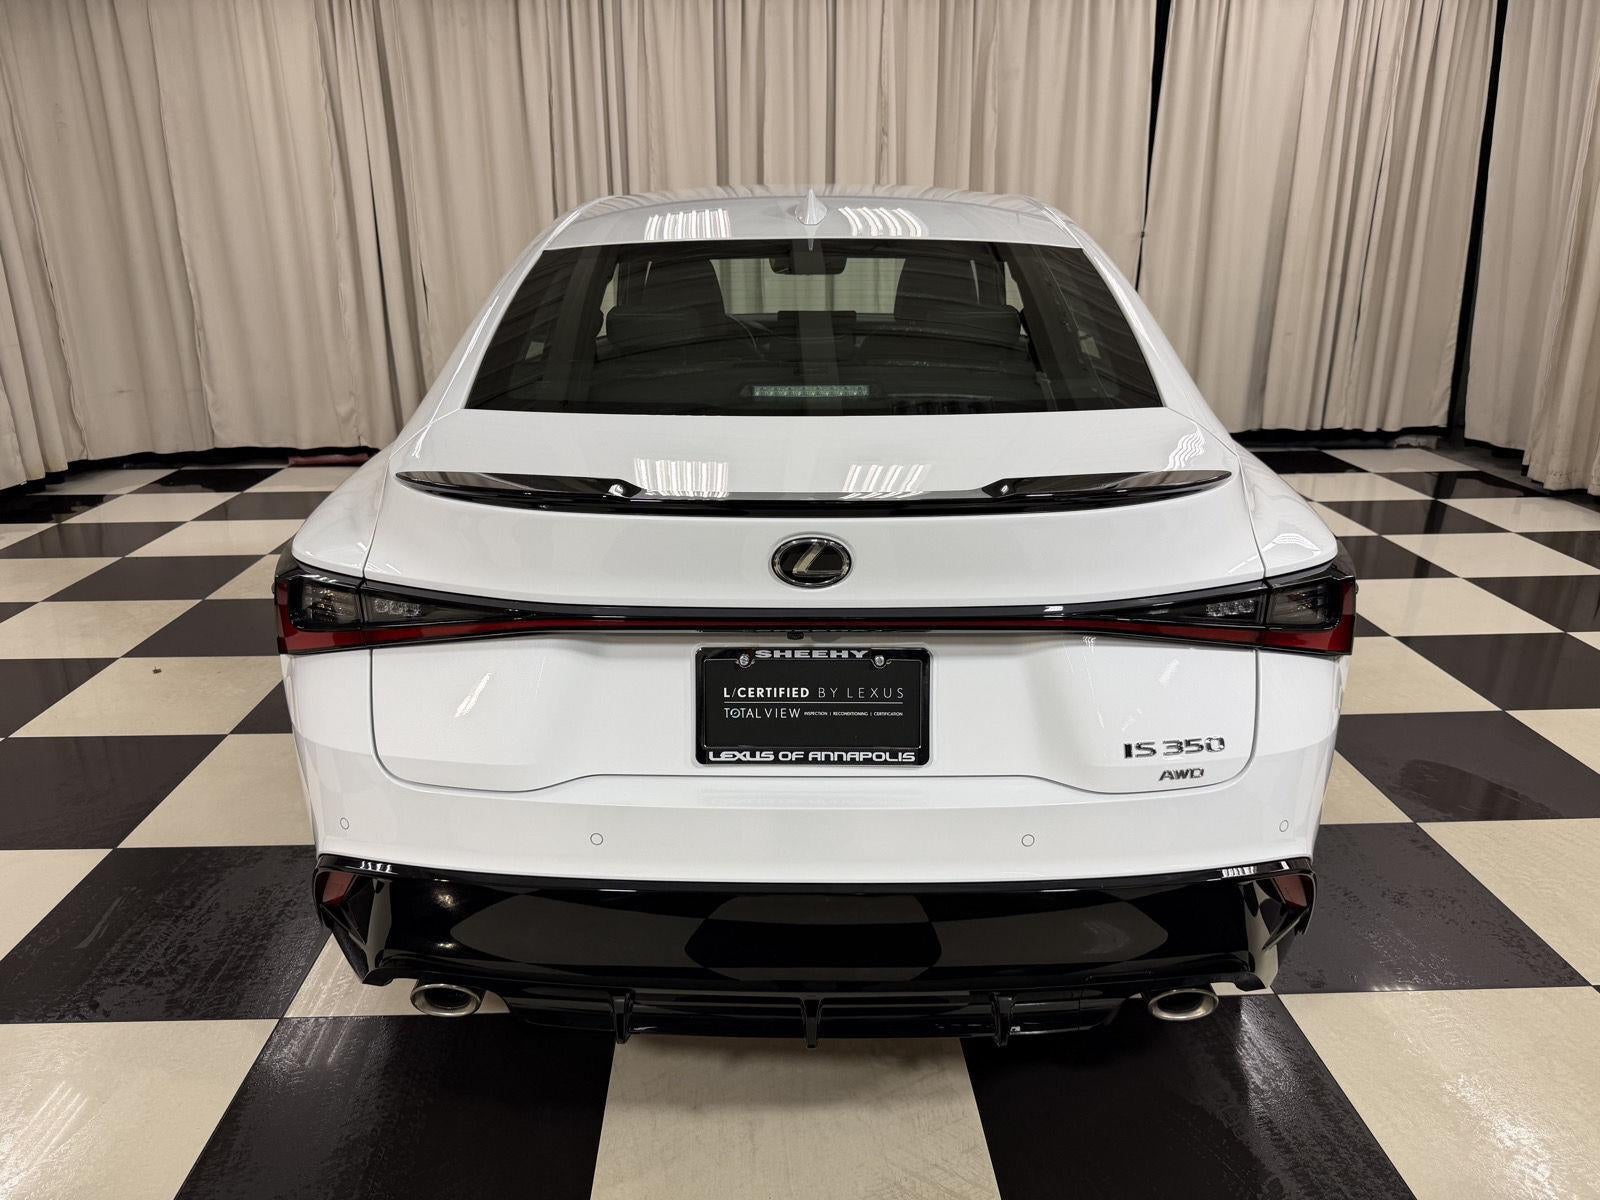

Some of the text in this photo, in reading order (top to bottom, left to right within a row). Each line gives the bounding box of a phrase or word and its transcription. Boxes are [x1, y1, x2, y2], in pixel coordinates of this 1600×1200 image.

[755, 650, 868, 658] SHEEHY
[723, 687, 904, 699] L/CERTIFIED BY LEXUS
[1124, 736, 1225, 759] IS 350
[708, 751, 916, 762] LEXUS OF ANNAPOLIS
[1158, 767, 1205, 781] AWD
